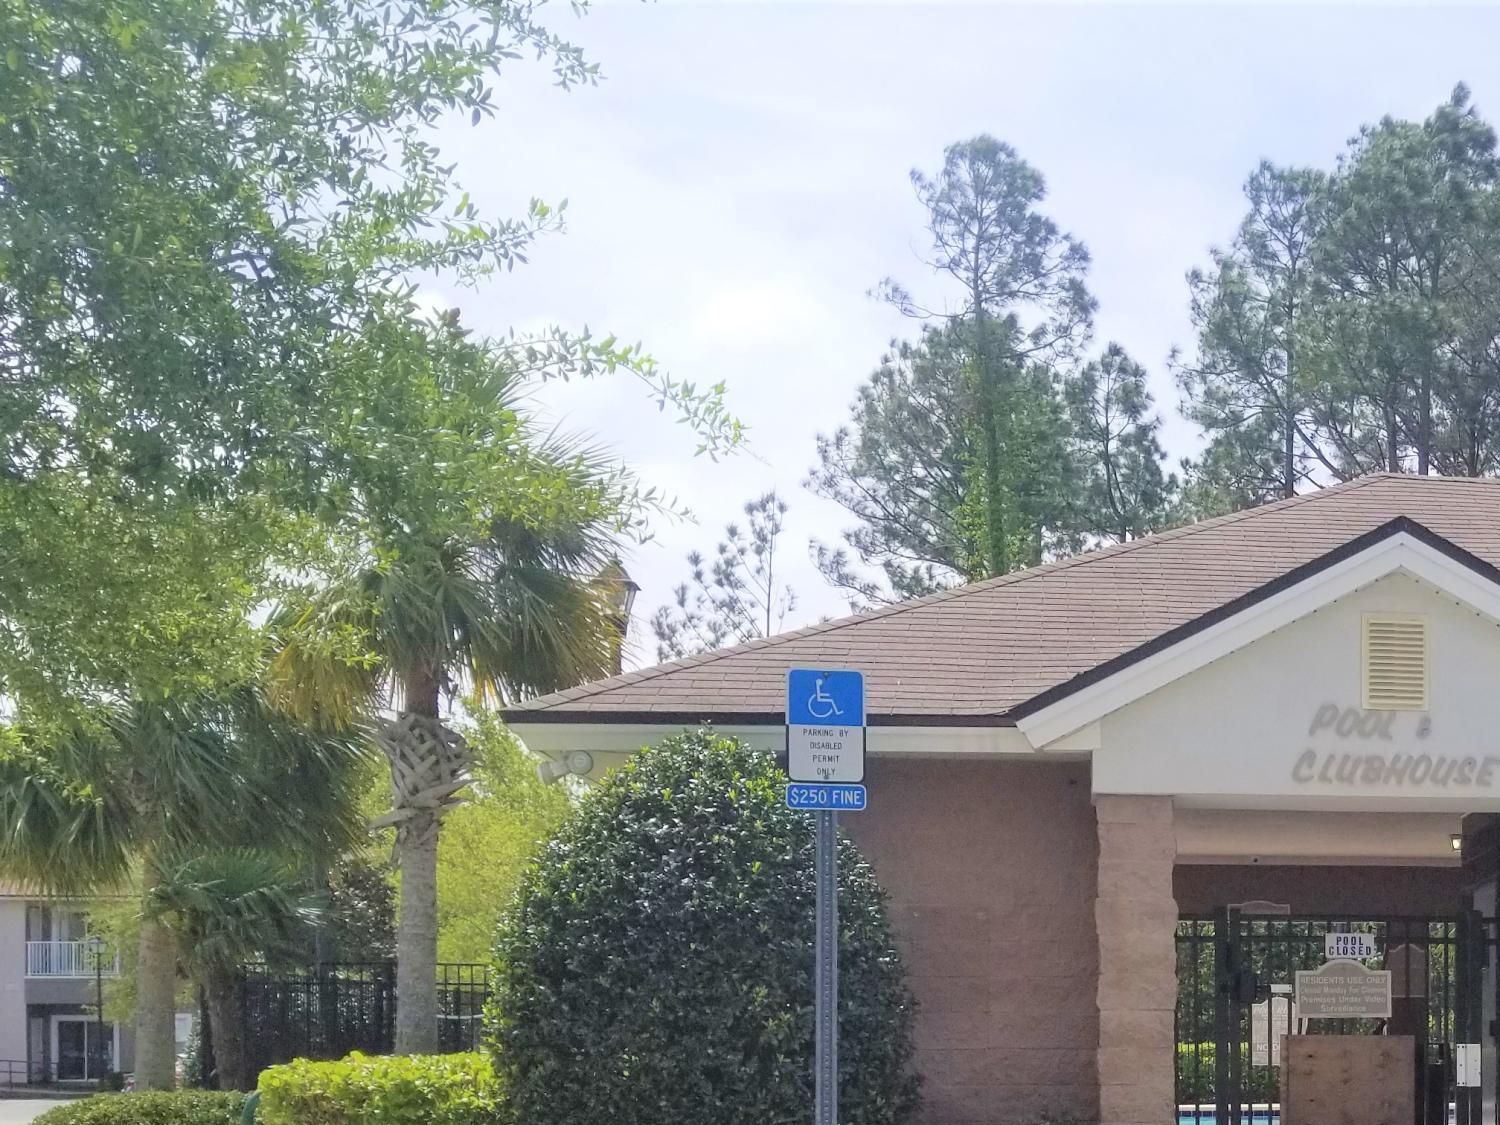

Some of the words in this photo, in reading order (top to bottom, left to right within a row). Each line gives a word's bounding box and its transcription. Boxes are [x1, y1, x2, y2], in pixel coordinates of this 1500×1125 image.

[1308, 703, 1396, 740] POOL
[802, 728, 834, 737] PARKING
[839, 729, 849, 737] BY
[809, 741, 843, 750] DISABLED
[812, 754, 840, 763] PERMIT
[816, 767, 836, 776] ONLY
[1291, 749, 1500, 786] CLUBHOUSE
[790, 787, 827, 805] $250
[832, 789, 862, 805] FINE
[1336, 936, 1364, 946] POOL
[1328, 946, 1372, 956] CLOSED
[1301, 976, 1345, 984] RESIDENTS
[1347, 976, 1364, 984] USE
[1366, 976, 1386, 984] ONLY
